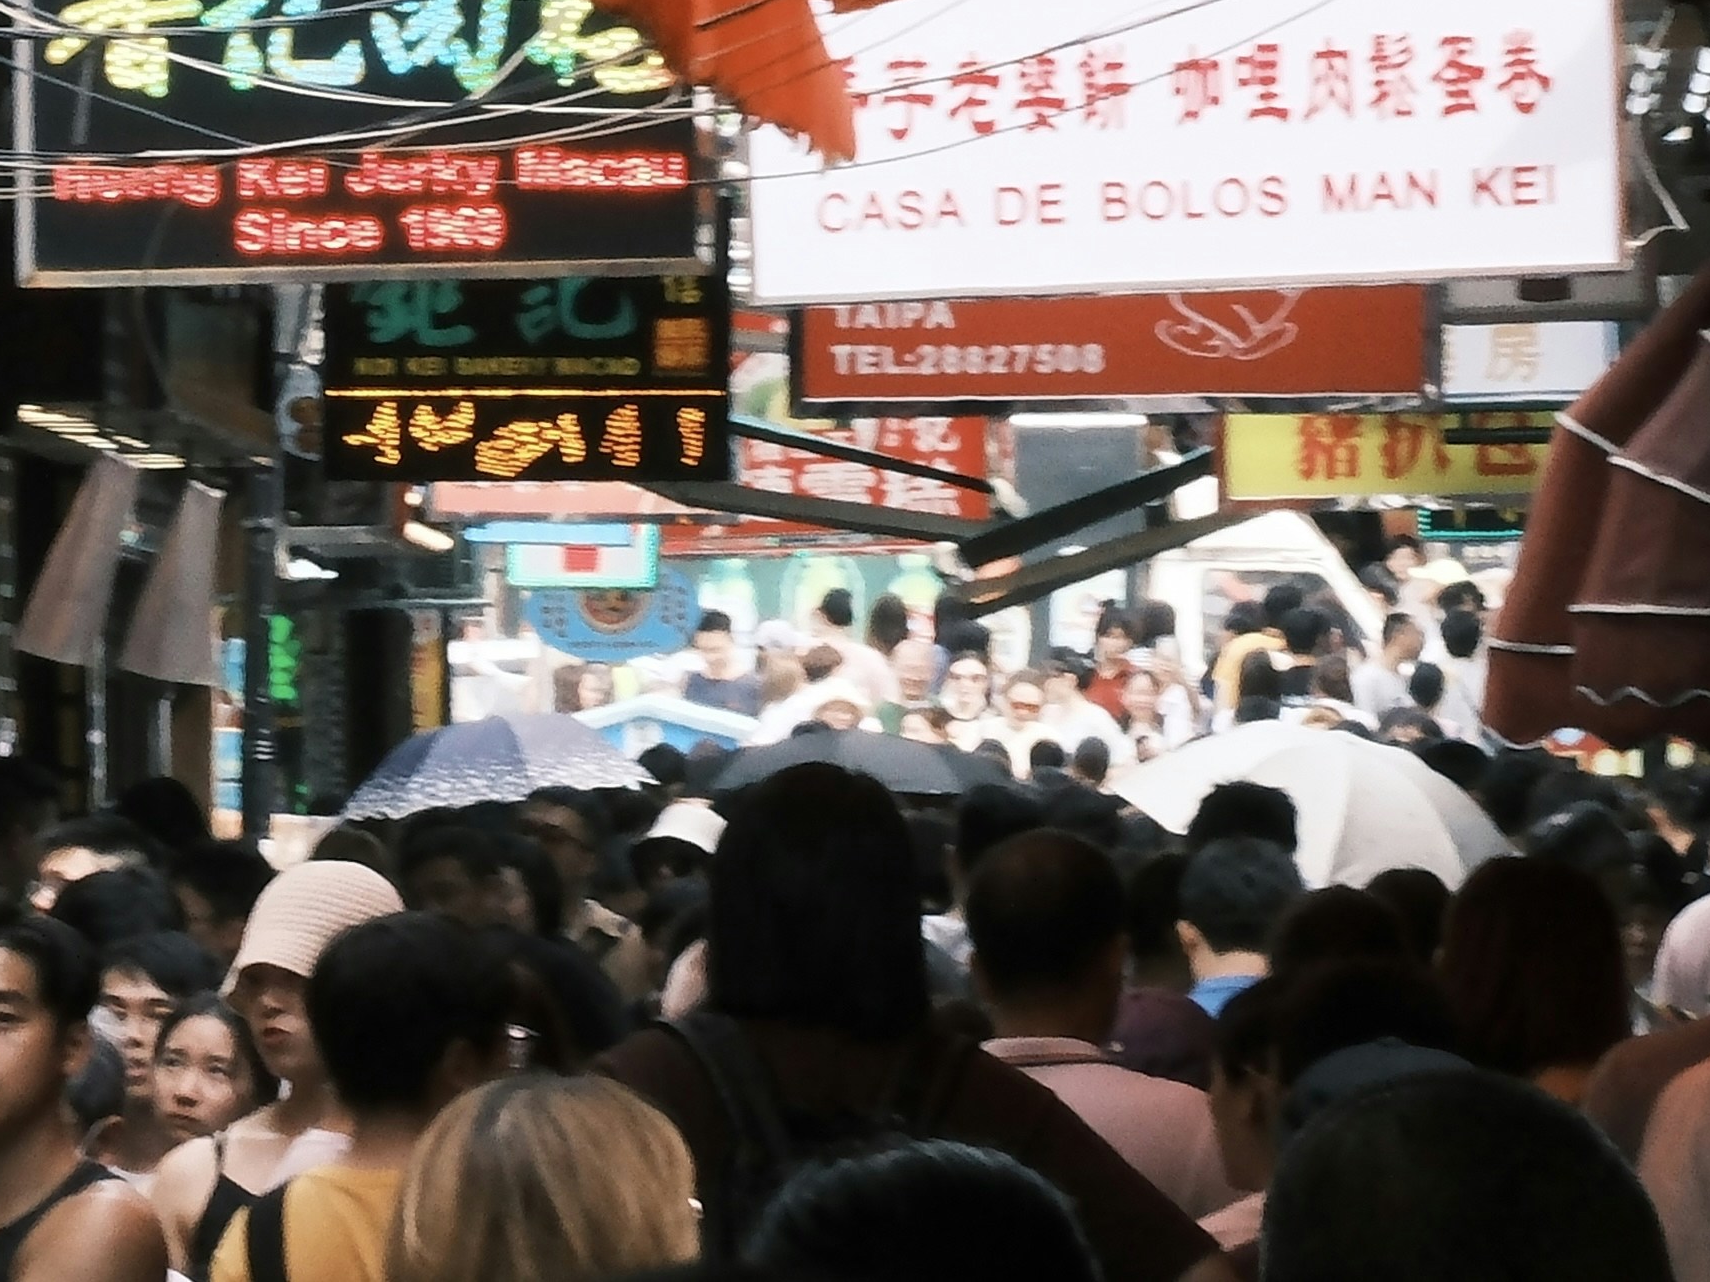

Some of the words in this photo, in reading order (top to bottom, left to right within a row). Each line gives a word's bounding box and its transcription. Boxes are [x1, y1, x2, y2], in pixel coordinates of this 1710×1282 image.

[236, 158, 329, 198] Kei
[818, 188, 965, 234] CASA
[994, 184, 1067, 226] DE
[1102, 174, 1289, 223] BOLOS
[1321, 168, 1441, 214] MAN
[1472, 162, 1558, 207] KEI
[234, 208, 384, 254] Since
